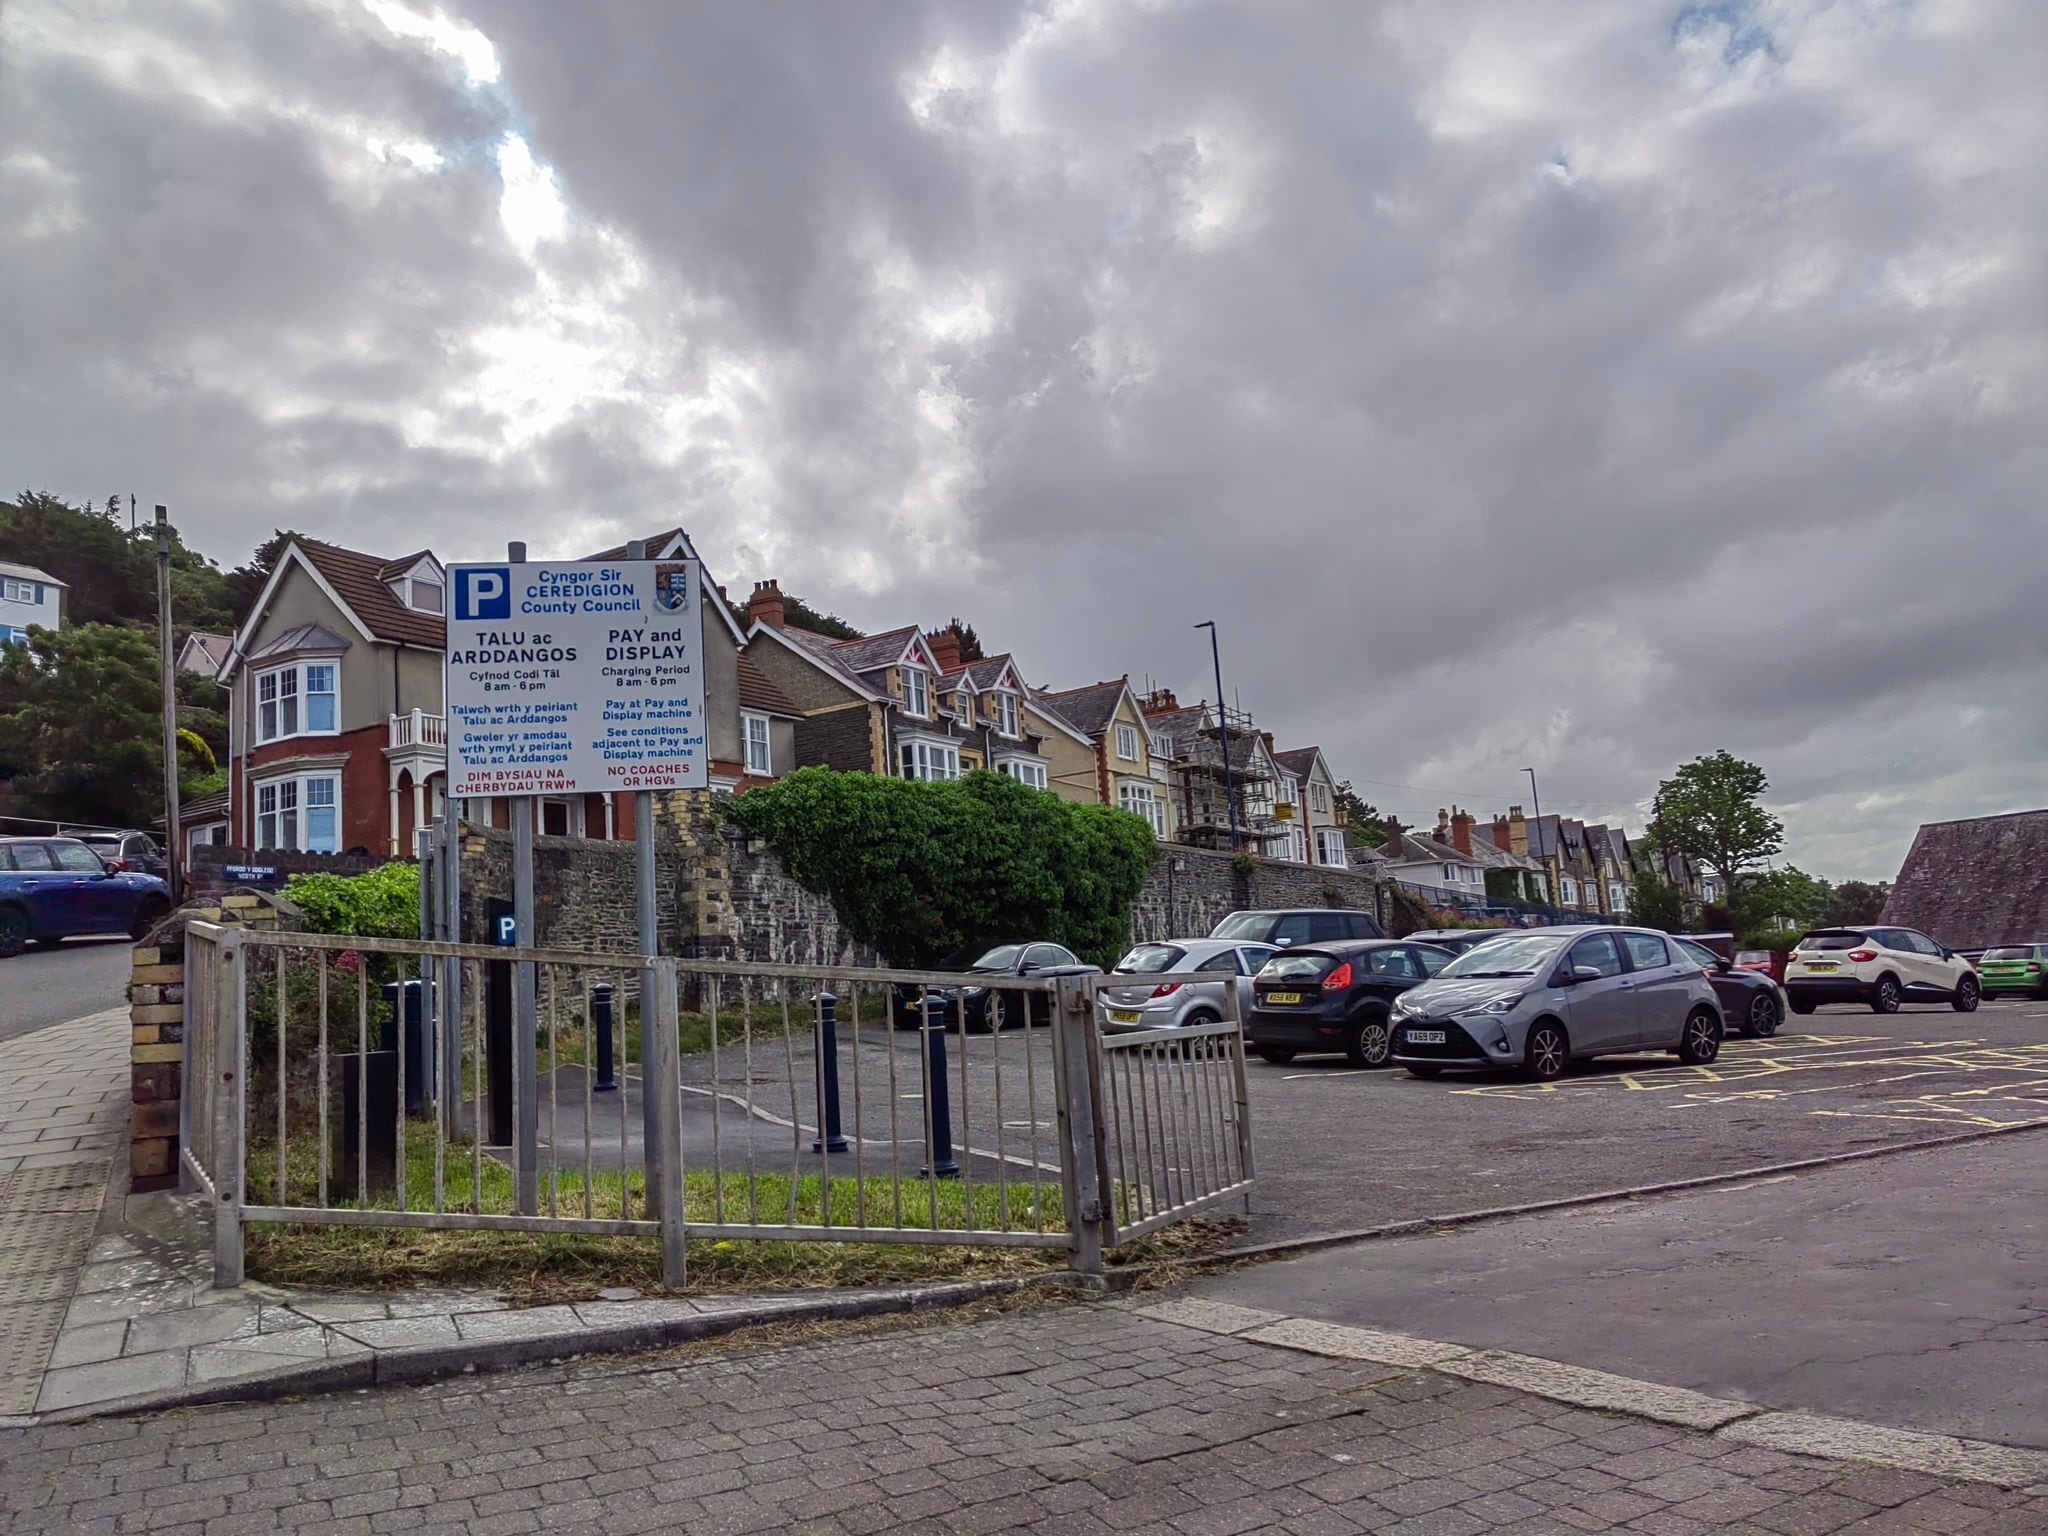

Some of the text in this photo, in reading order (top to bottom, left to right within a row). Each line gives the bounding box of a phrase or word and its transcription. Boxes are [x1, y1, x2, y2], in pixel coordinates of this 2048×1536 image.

[539, 569, 621, 584] Cyngor Sir
[468, 573, 503, 616] P
[527, 584, 634, 597] CEREDIGION
[522, 599, 641, 615] County Council
[476, 632, 551, 645] TALU ac
[609, 629, 681, 642] PAY and
[451, 648, 577, 664] ARDDANGOS
[606, 646, 686, 661] DISPLAY
[470, 669, 560, 681] Cyfnod Codi Tâl
[602, 665, 690, 677] Charging Period
[520, 682, 526, 690] 6
[529, 683, 546, 691] pm
[617, 678, 623, 686] 8
[651, 677, 657, 685] 6
[660, 678, 676, 688] pm
[452, 702, 578, 714] Talwch wrth y peiriant
[606, 698, 688, 710] Pay at Pay and
[463, 716, 486, 725] Talu
[507, 714, 567, 726] Arddangos
[603, 710, 692, 721] Display machine
[464, 730, 567, 743] Gweler yr amodau
[607, 726, 688, 737] See conditions
[459, 742, 572, 754] wrth ymyl y peiriant
[592, 739, 640, 749] adjacent
[660, 737, 679, 747] Pay
[683, 736, 703, 745] and
[464, 755, 487, 764] Talu
[508, 753, 568, 765] Arddangos
[604, 749, 693, 760] Display machine
[468, 770, 564, 782] DIM BYSIAU NA
[608, 764, 689, 776] NO COACHES
[456, 780, 576, 794] CHERBYDAU TRWM
[624, 776, 675, 786] OR HGVs
[500, 917, 516, 940] P
